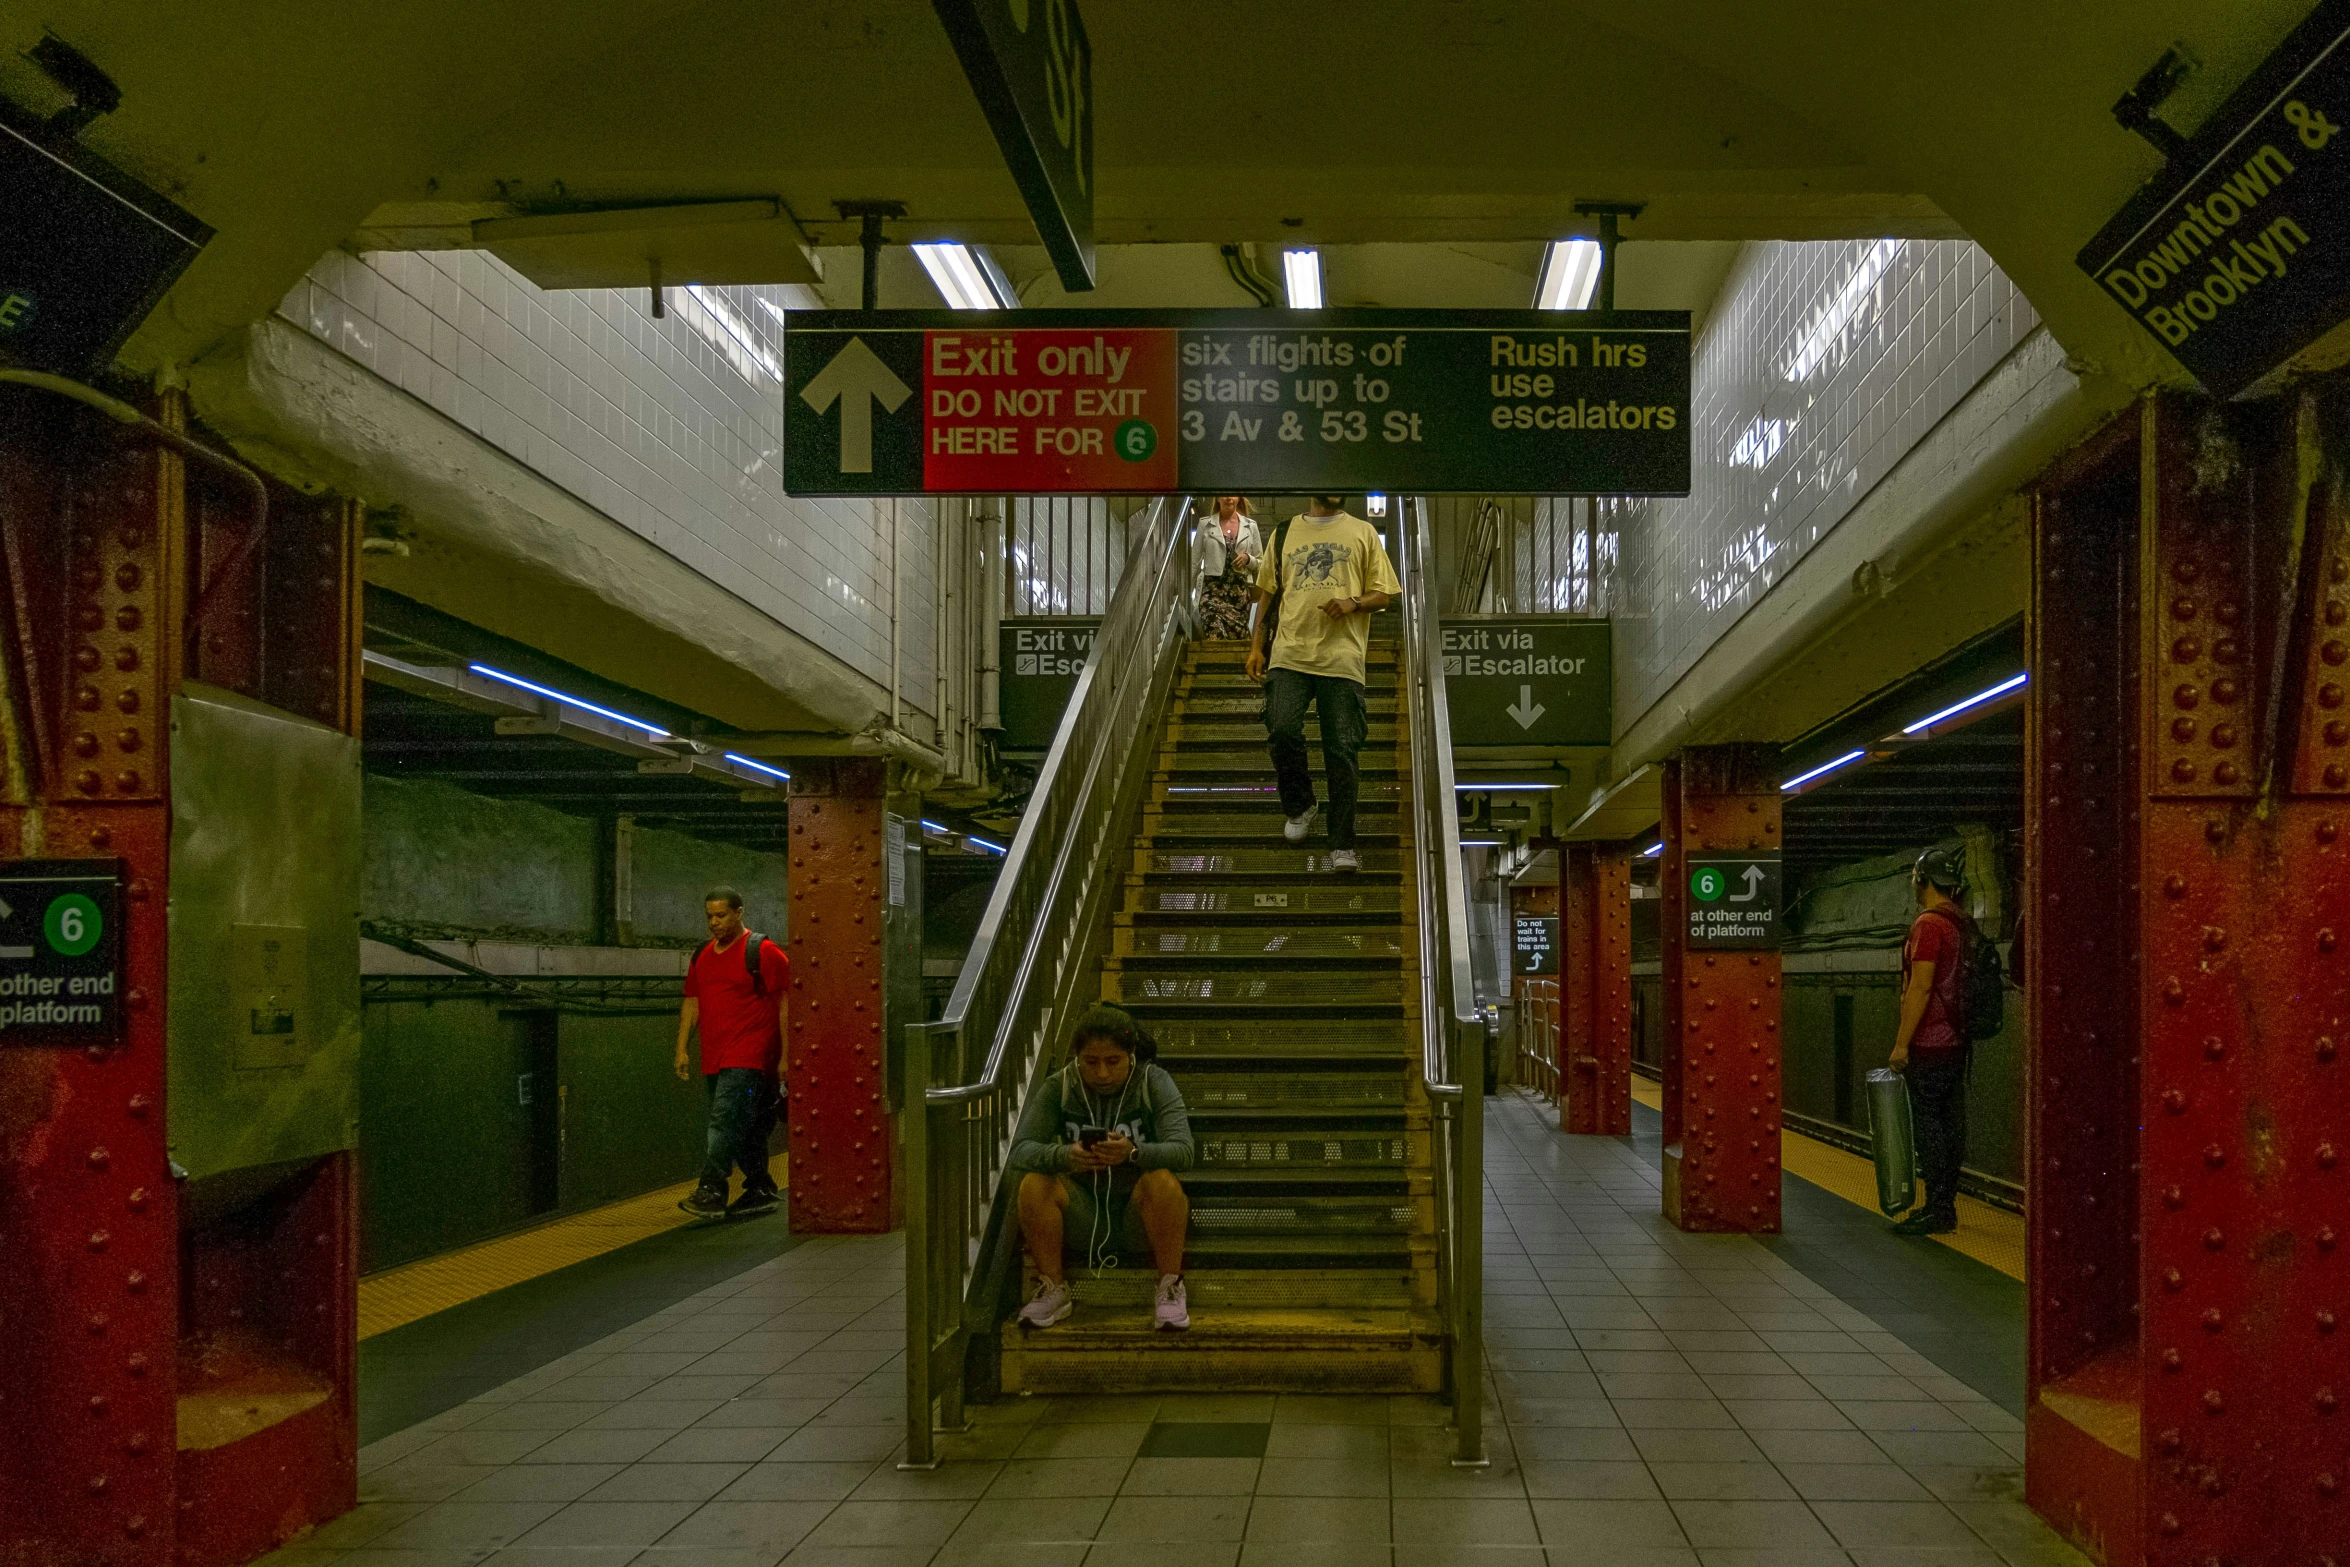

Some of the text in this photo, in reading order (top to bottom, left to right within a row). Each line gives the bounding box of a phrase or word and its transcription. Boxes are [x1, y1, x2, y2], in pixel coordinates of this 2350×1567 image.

[2104, 99, 2341, 310] Downtown &
[2144, 215, 2311, 347] Brooklyn
[0, 295, 30, 327] E
[931, 336, 1132, 384] Exit only
[1181, 335, 1407, 373] six flights of
[1490, 335, 1648, 368] Rush hrs
[1182, 372, 1390, 409] stairs up to
[1490, 373, 1555, 398] use
[931, 388, 1147, 418] DO NOT EXIT
[1490, 398, 1677, 430] escalators
[931, 427, 1148, 456] HERE FOR 6
[1181, 410, 1424, 443] 3 Av & 53 St
[1016, 629, 1095, 651] Exit vi
[1440, 628, 1534, 651] Exit via
[1039, 654, 1087, 676] Esc
[1465, 654, 1586, 676] Escalator
[1700, 874, 1714, 894] 6
[61, 907, 85, 942] 6
[1690, 908, 1772, 922] at other end
[1517, 927, 1546, 935] wait for
[1690, 923, 1765, 940] of platform
[0, 970, 116, 996] other end
[0, 1000, 102, 1030] platform
